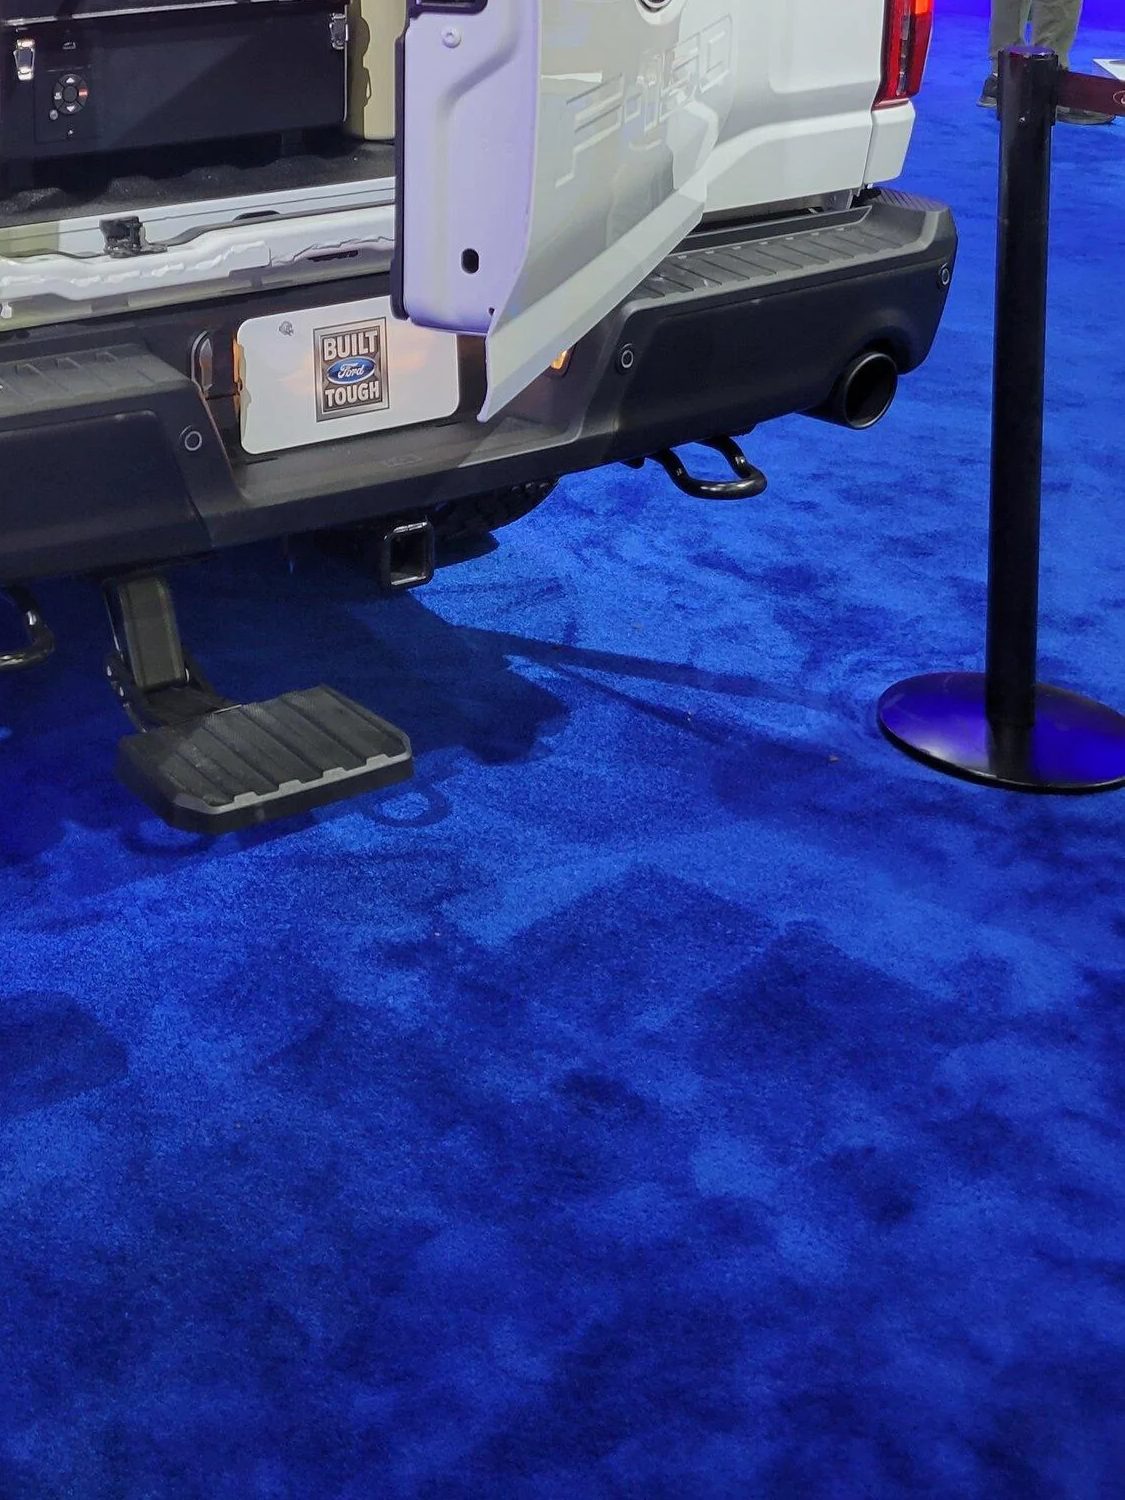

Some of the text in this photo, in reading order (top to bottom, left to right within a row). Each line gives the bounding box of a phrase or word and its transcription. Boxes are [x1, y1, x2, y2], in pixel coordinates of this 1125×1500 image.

[323, 330, 378, 361] BUILT
[337, 362, 365, 379] Ford
[324, 381, 380, 407] TOUGH
